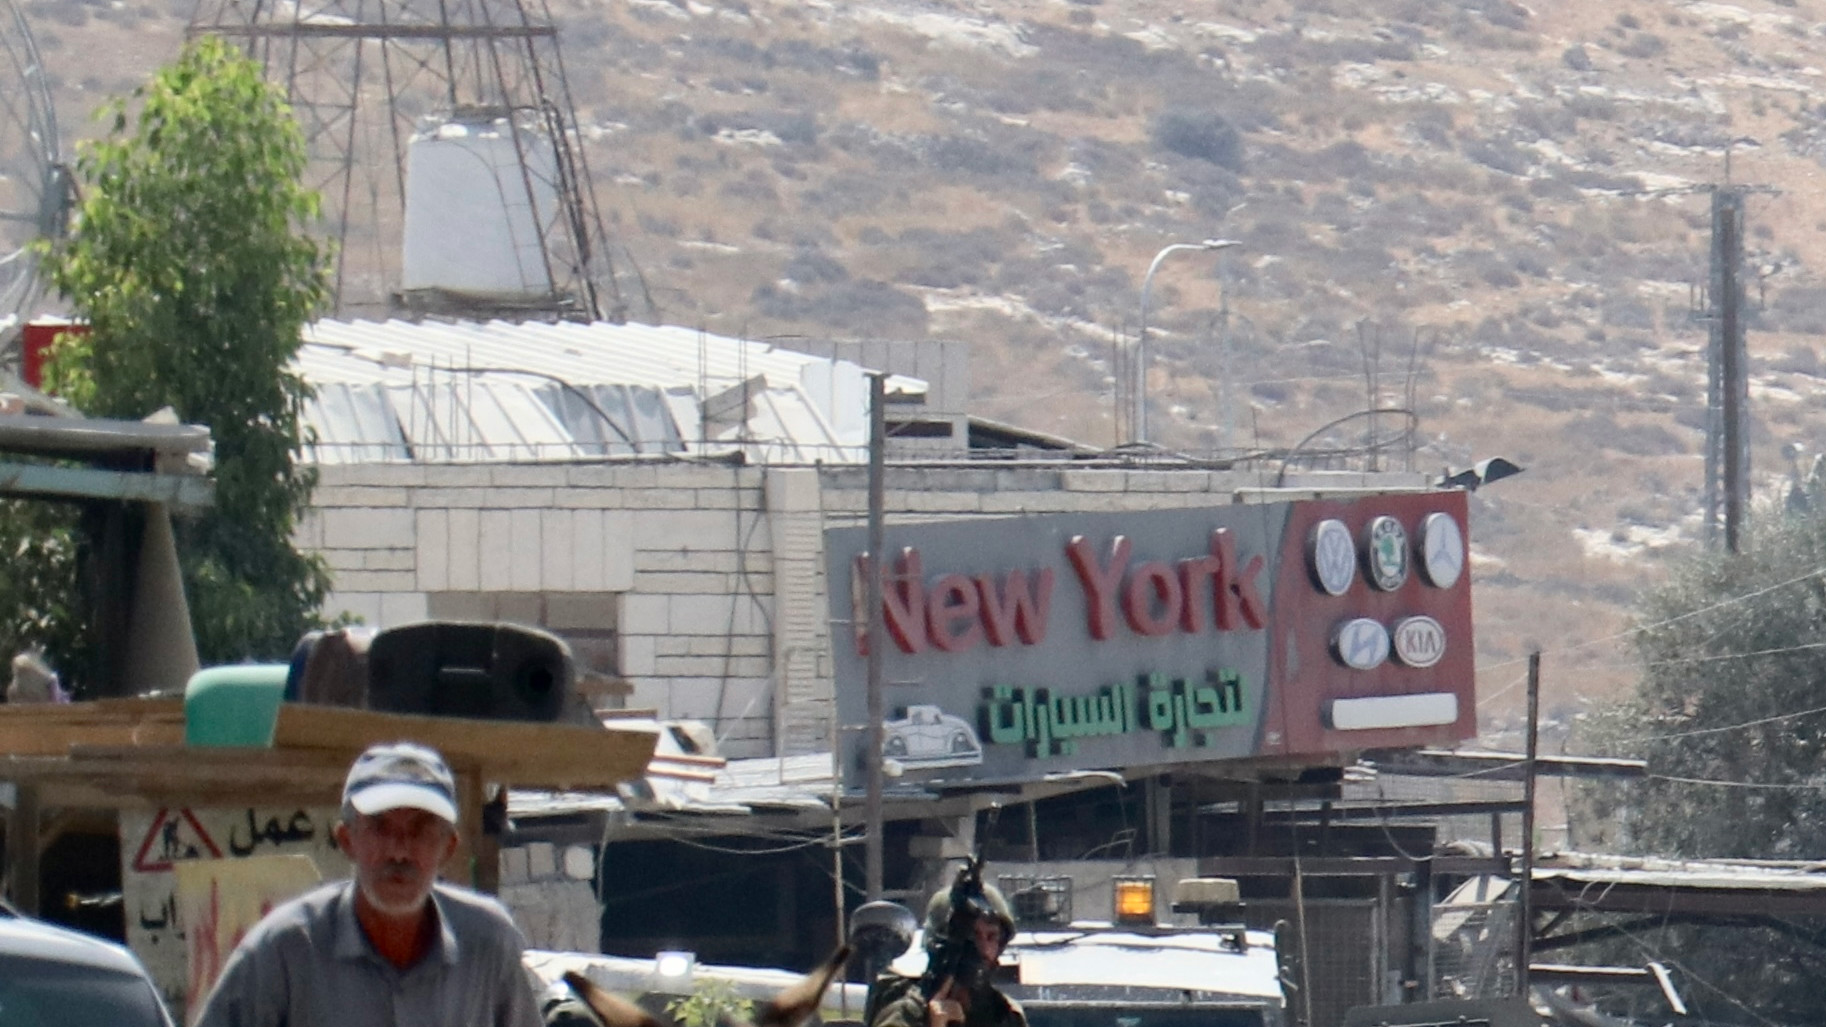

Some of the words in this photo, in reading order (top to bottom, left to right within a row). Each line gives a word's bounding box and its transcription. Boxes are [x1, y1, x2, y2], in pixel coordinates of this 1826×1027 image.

[852, 545, 1054, 655] New
[1066, 526, 1268, 641] York
[229, 808, 316, 858] عمل
